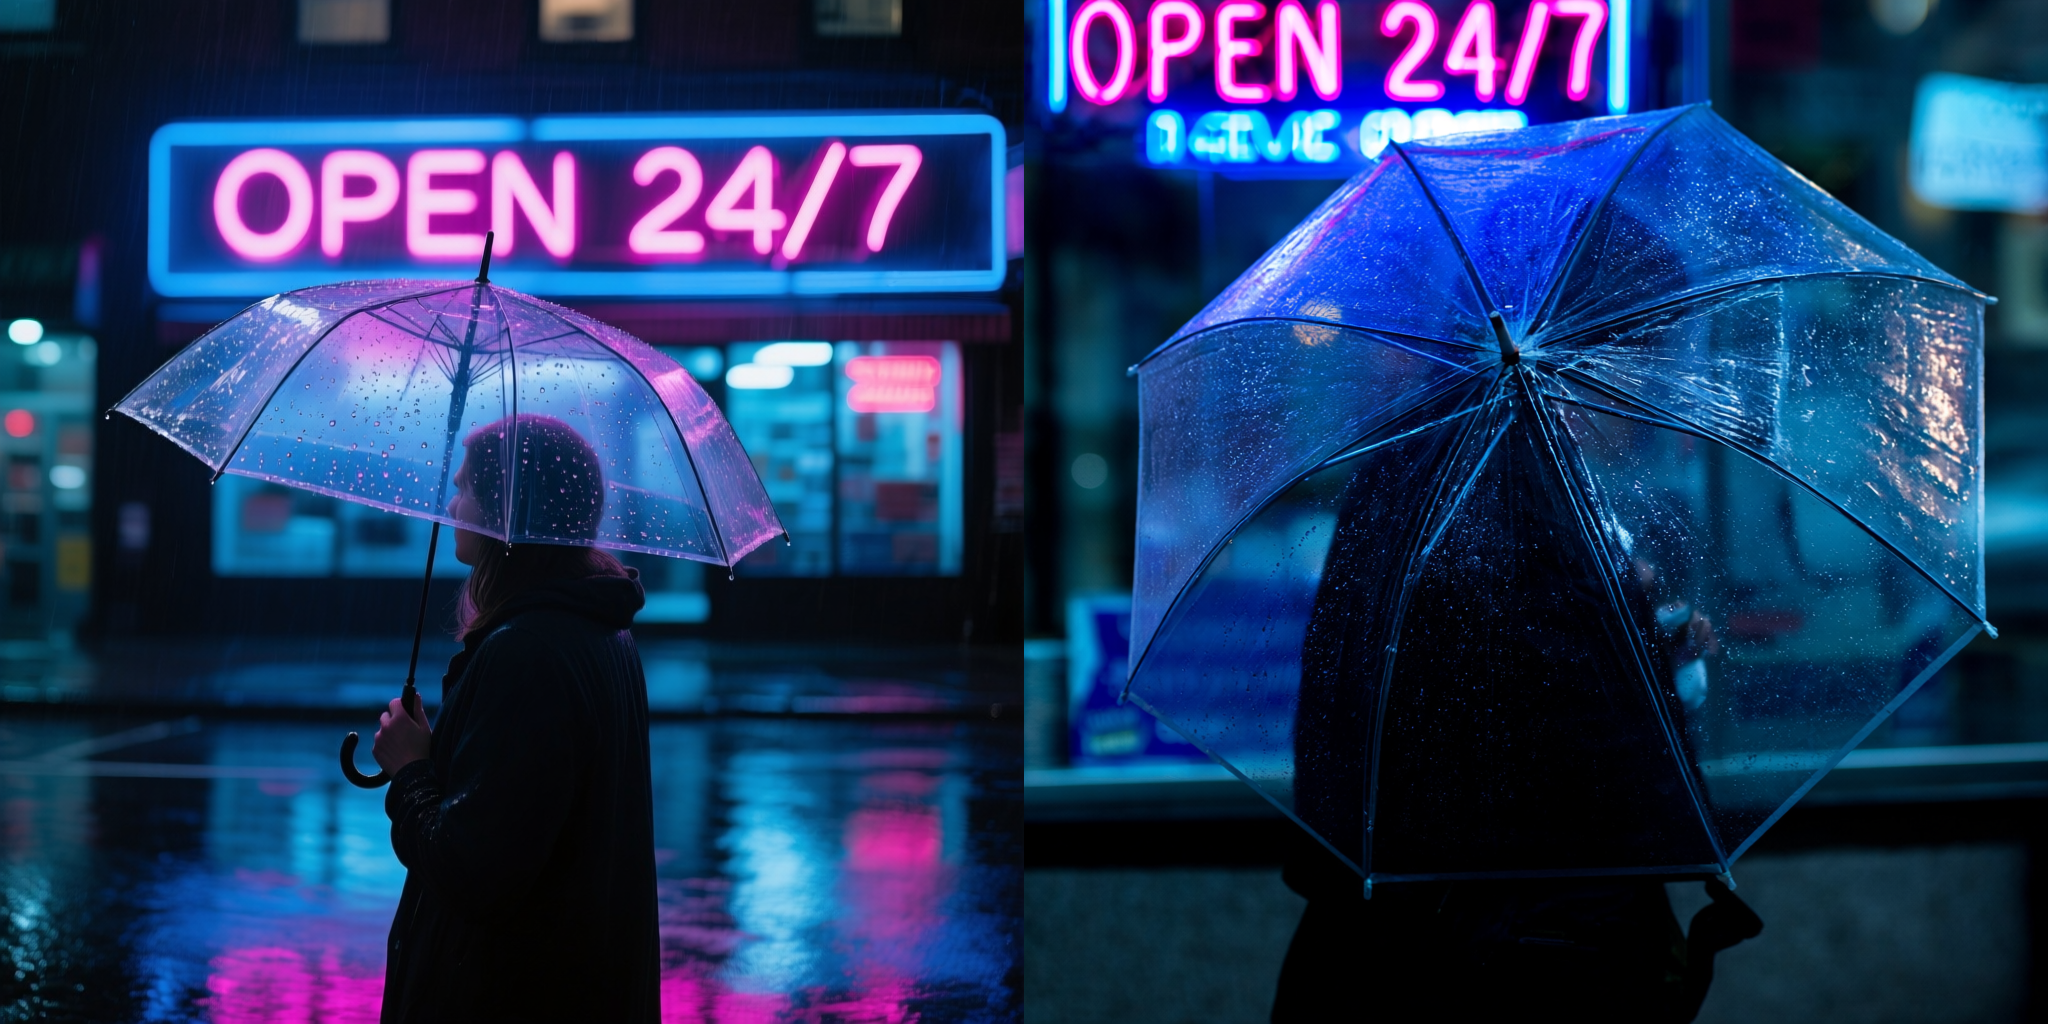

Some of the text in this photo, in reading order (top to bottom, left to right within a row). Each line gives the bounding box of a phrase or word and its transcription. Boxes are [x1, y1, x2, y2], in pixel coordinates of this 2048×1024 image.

[1069, 0, 1608, 105] OPEN 24/7
[213, 141, 923, 261] OPEN 24/7
